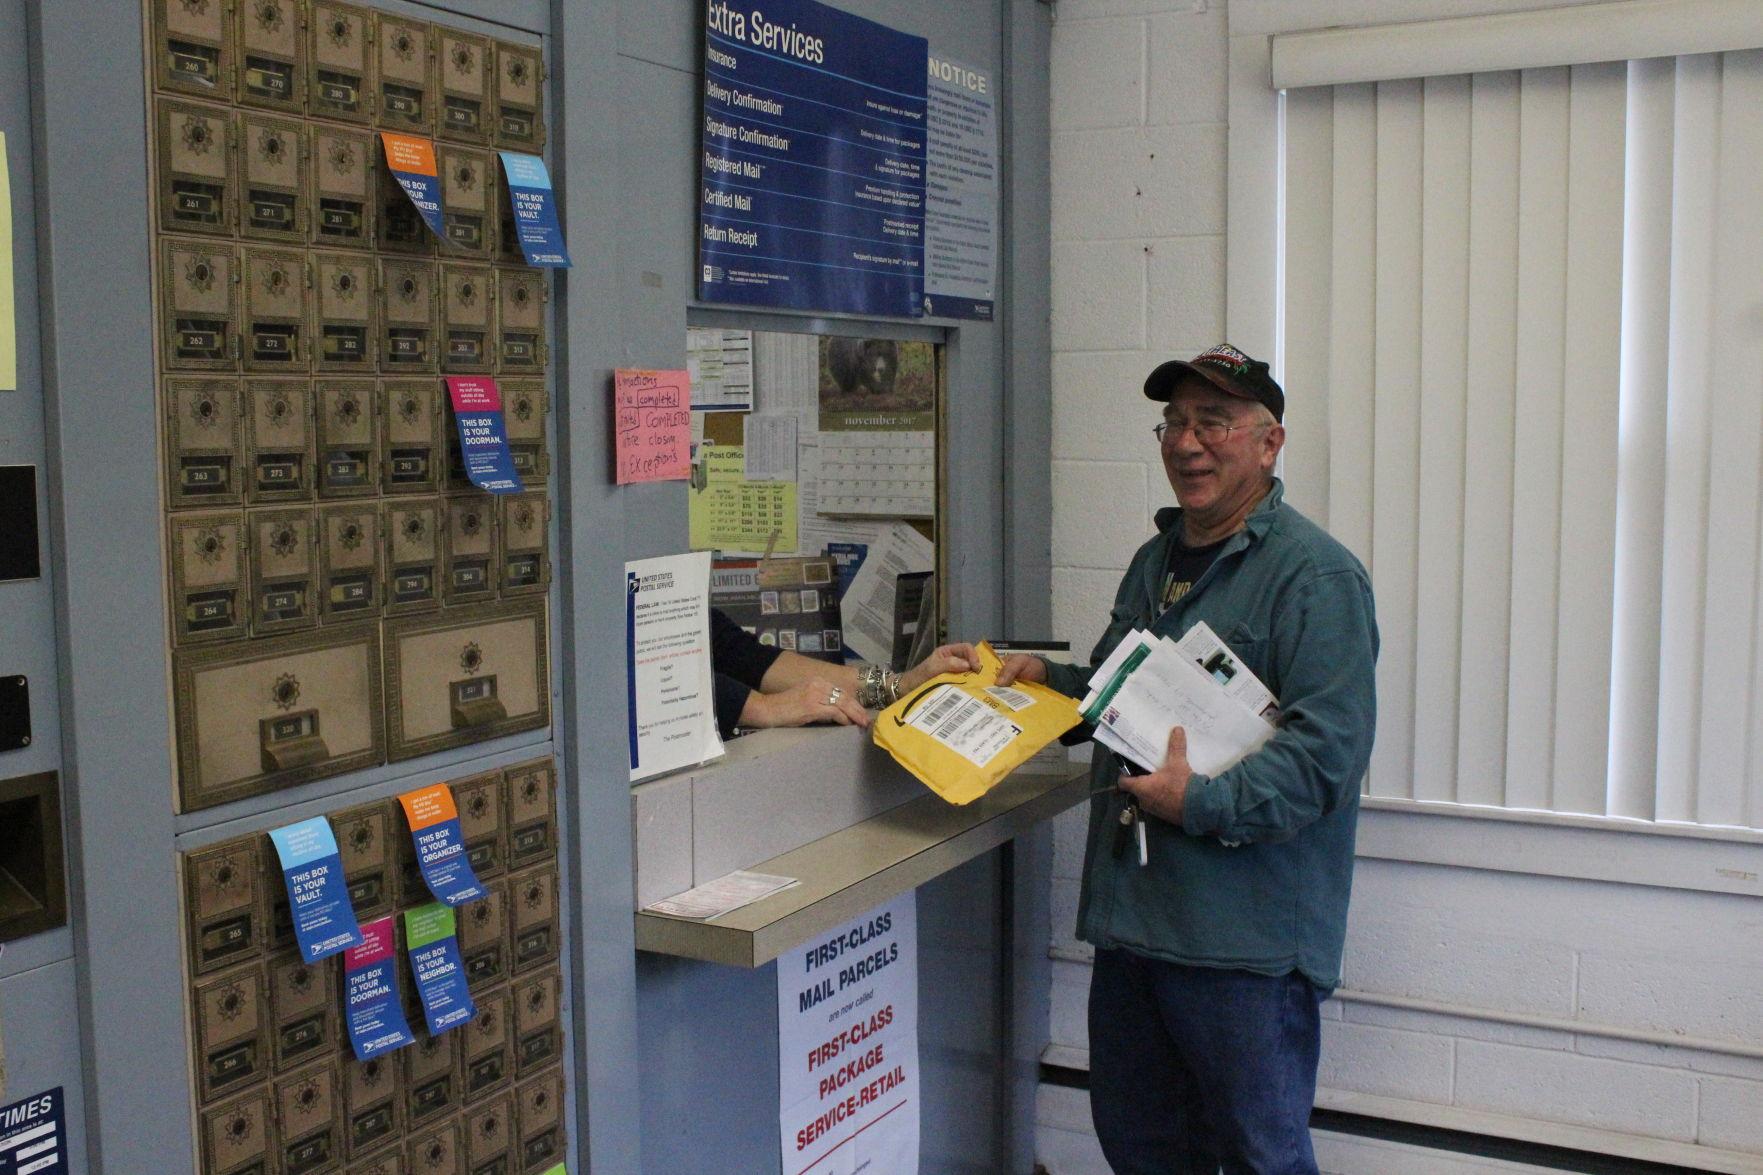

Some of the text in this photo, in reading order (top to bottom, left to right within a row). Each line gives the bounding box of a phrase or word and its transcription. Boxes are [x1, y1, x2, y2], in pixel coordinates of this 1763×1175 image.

[707, 0, 824, 64] Extra Services
[707, 44, 737, 70] Insurance
[185, 63, 199, 71] 260
[271, 78, 283, 88] 270
[927, 57, 987, 94] NOTICE
[707, 80, 783, 116] Delivery Confirmation
[706, 116, 789, 151] Signature Confirmation
[705, 152, 742, 176] Registered
[412, 179, 427, 191] BOX
[408, 189, 424, 200] OUR
[515, 192, 544, 203] THIS BOX
[704, 187, 733, 208] Certified
[186, 199, 199, 208] 261
[517, 201, 542, 211] IS YOUR
[262, 208, 274, 216] 271
[518, 210, 540, 220] VAULT.
[704, 223, 758, 249] Return Receipt
[190, 337, 204, 345] 262
[266, 339, 278, 347] 272
[399, 342, 410, 350] 292
[461, 418, 493, 427] THIS BOX
[845, 415, 897, 425] november
[464, 427, 490, 436] IS YOUR
[465, 436, 503, 445] DOORMAN.
[709, 451, 744, 459] Post Offic
[194, 472, 207, 480] 263
[641, 572, 673, 583] UNITED STATES
[713, 574, 751, 587] LIMITED
[351, 587, 363, 596] 284
[640, 581, 675, 592] POSTAL SERVICE
[275, 598, 287, 606] 274
[204, 607, 217, 615] 264
[418, 828, 450, 845] THIS BOX
[420, 839, 448, 854] IS YOUR
[422, 844, 463, 863] ORGANIZER.
[291, 865, 329, 884] THIS BOX
[293, 876, 326, 895] IS YOUR
[295, 888, 323, 904] VAULT.
[229, 928, 242, 939] 265
[805, 912, 892, 973] FIRST-CLASS
[415, 946, 447, 963] THIS BOX
[417, 958, 445, 973] IS YOUR
[420, 962, 457, 982] NEIGHBOR.
[350, 967, 382, 986] THIS BOX
[799, 942, 898, 1013] MAIL PARCELS
[350, 978, 379, 995] IS YOUR
[350, 985, 391, 1005] DOORMAN.
[828, 988, 874, 1023] are now called
[808, 1004, 893, 1072] FIRST-CLASS
[819, 1043, 884, 1100] PACKAGE
[797, 1065, 906, 1151] SERVICE-RETAIL
